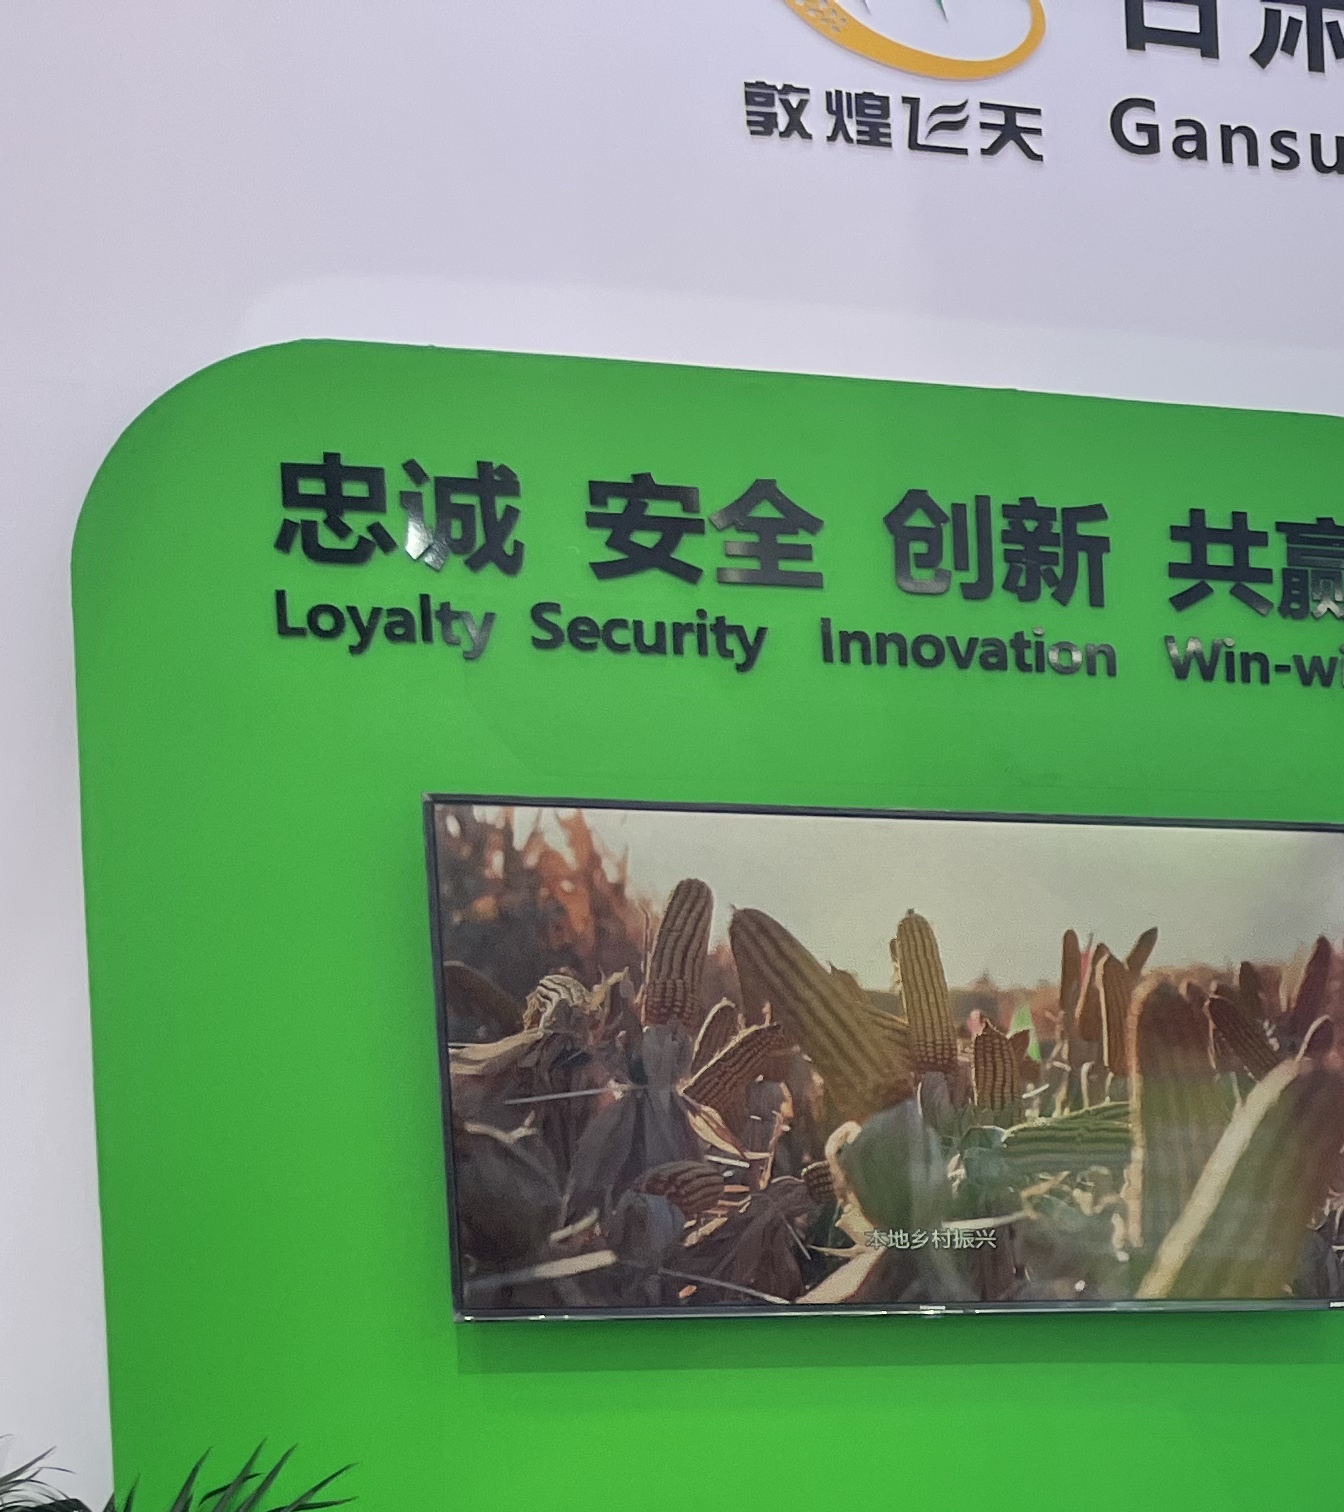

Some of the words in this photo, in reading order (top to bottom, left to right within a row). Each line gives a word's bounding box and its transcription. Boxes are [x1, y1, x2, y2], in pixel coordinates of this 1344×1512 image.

[743, 81, 1044, 162] 敦煌飞天
[274, 452, 524, 577] 忠诚
[586, 472, 824, 588] 安全
[883, 489, 1110, 608] 创新
[275, 589, 496, 660] Loyalty
[530, 601, 768, 673] Security
[820, 617, 1117, 677] Innovation
[867, 1229, 997, 1250] 本地乡村振兴
